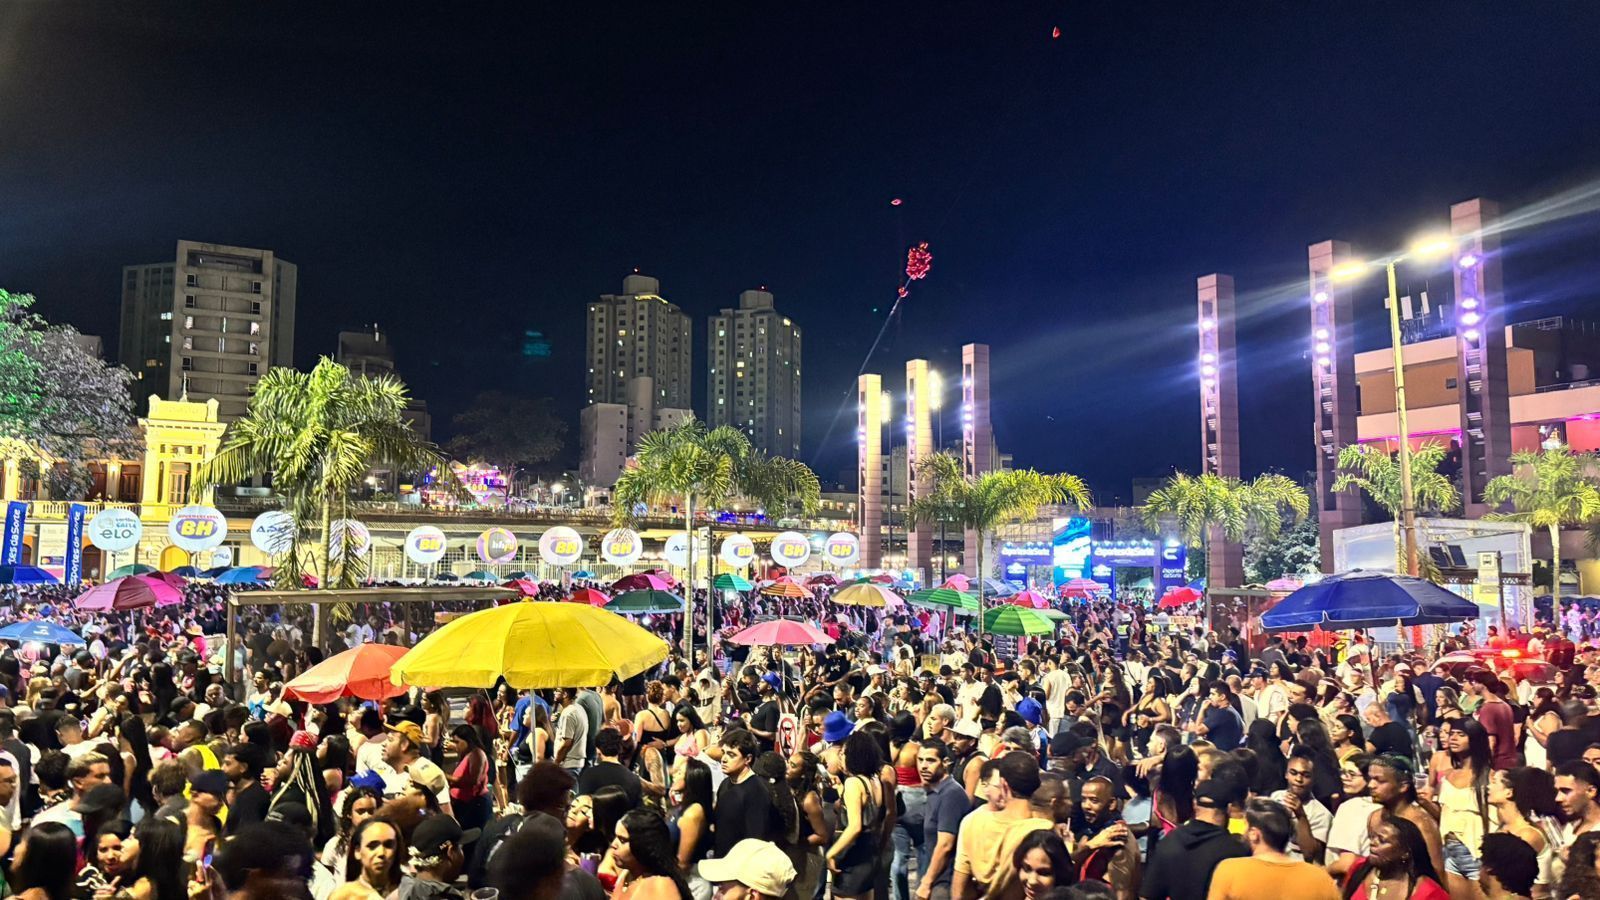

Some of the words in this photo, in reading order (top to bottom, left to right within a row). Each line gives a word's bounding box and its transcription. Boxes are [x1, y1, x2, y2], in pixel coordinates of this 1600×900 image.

[181, 520, 214, 536] BH
[555, 541, 578, 554] BH
[611, 542, 633, 554] BH
[784, 544, 805, 556] BH
[831, 544, 852, 556] BH
